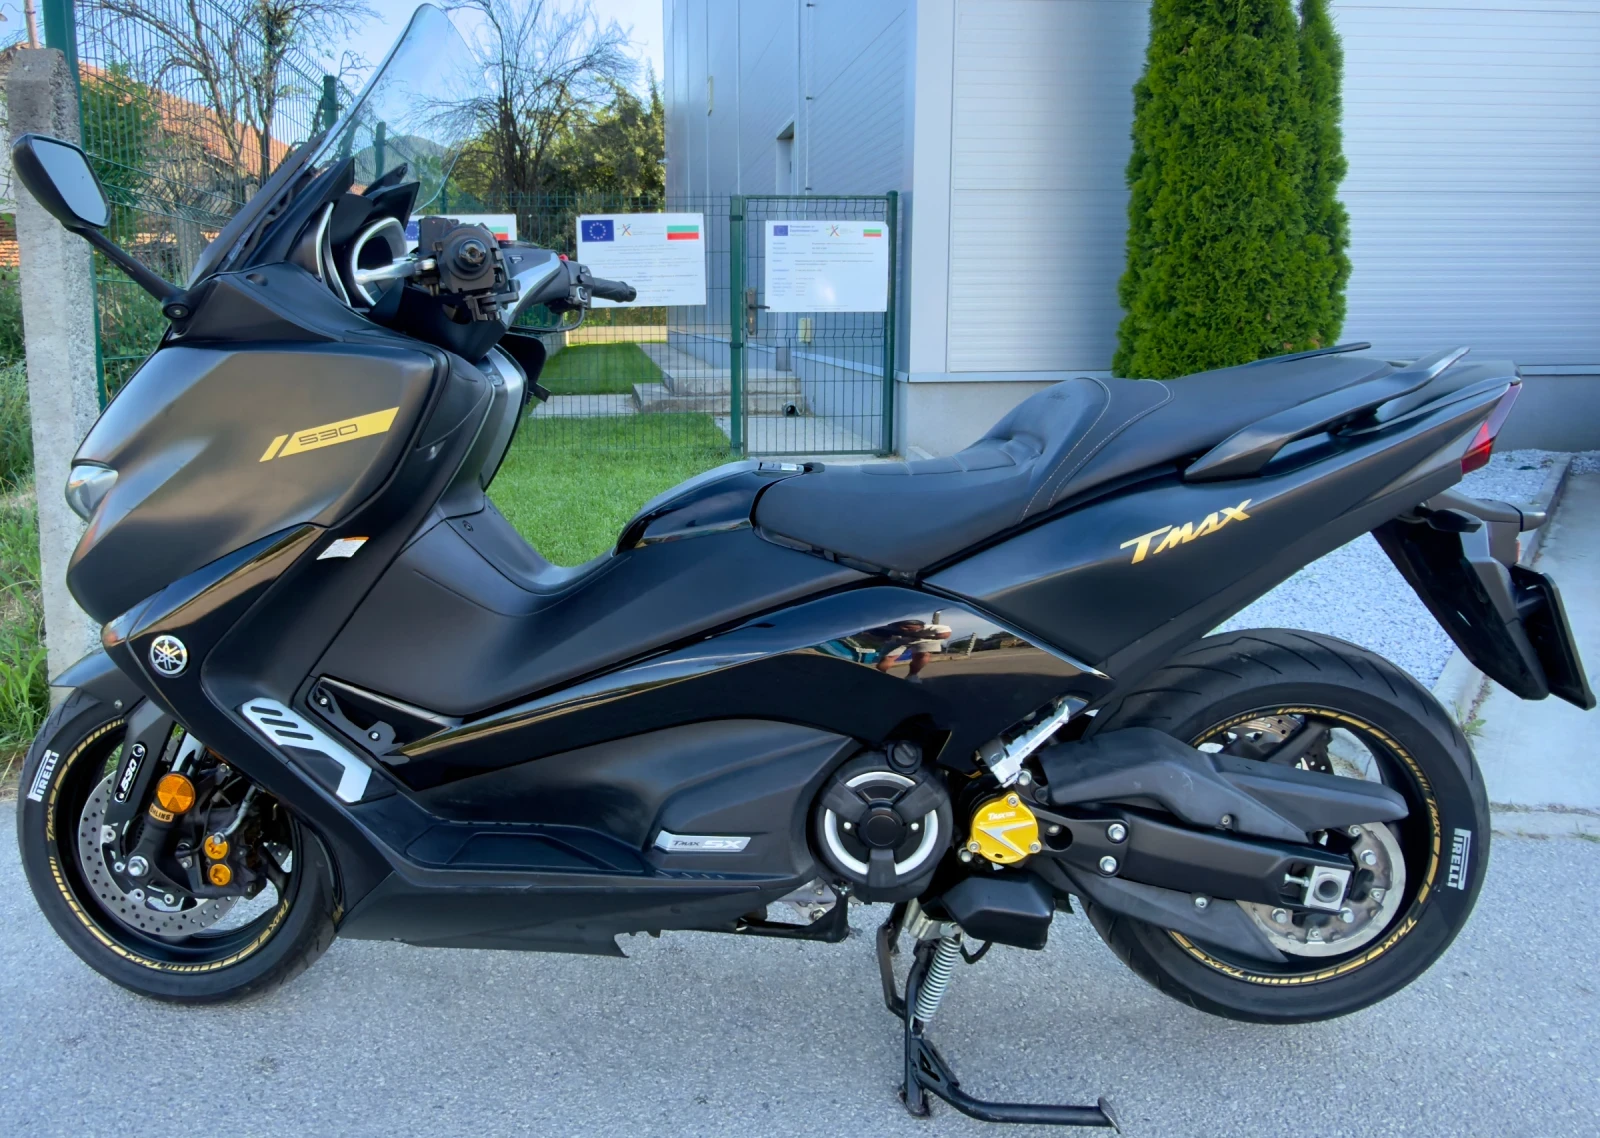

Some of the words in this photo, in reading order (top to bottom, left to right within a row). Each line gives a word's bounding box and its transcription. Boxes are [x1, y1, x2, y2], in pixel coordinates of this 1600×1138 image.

[299, 424, 358, 446] 530
[1119, 498, 1252, 565] TMAX
[27, 749, 60, 802] PIRELLI
[121, 758, 137, 791] 530
[702, 840, 742, 849] SX
[1446, 827, 1472, 890] PIRELLI
